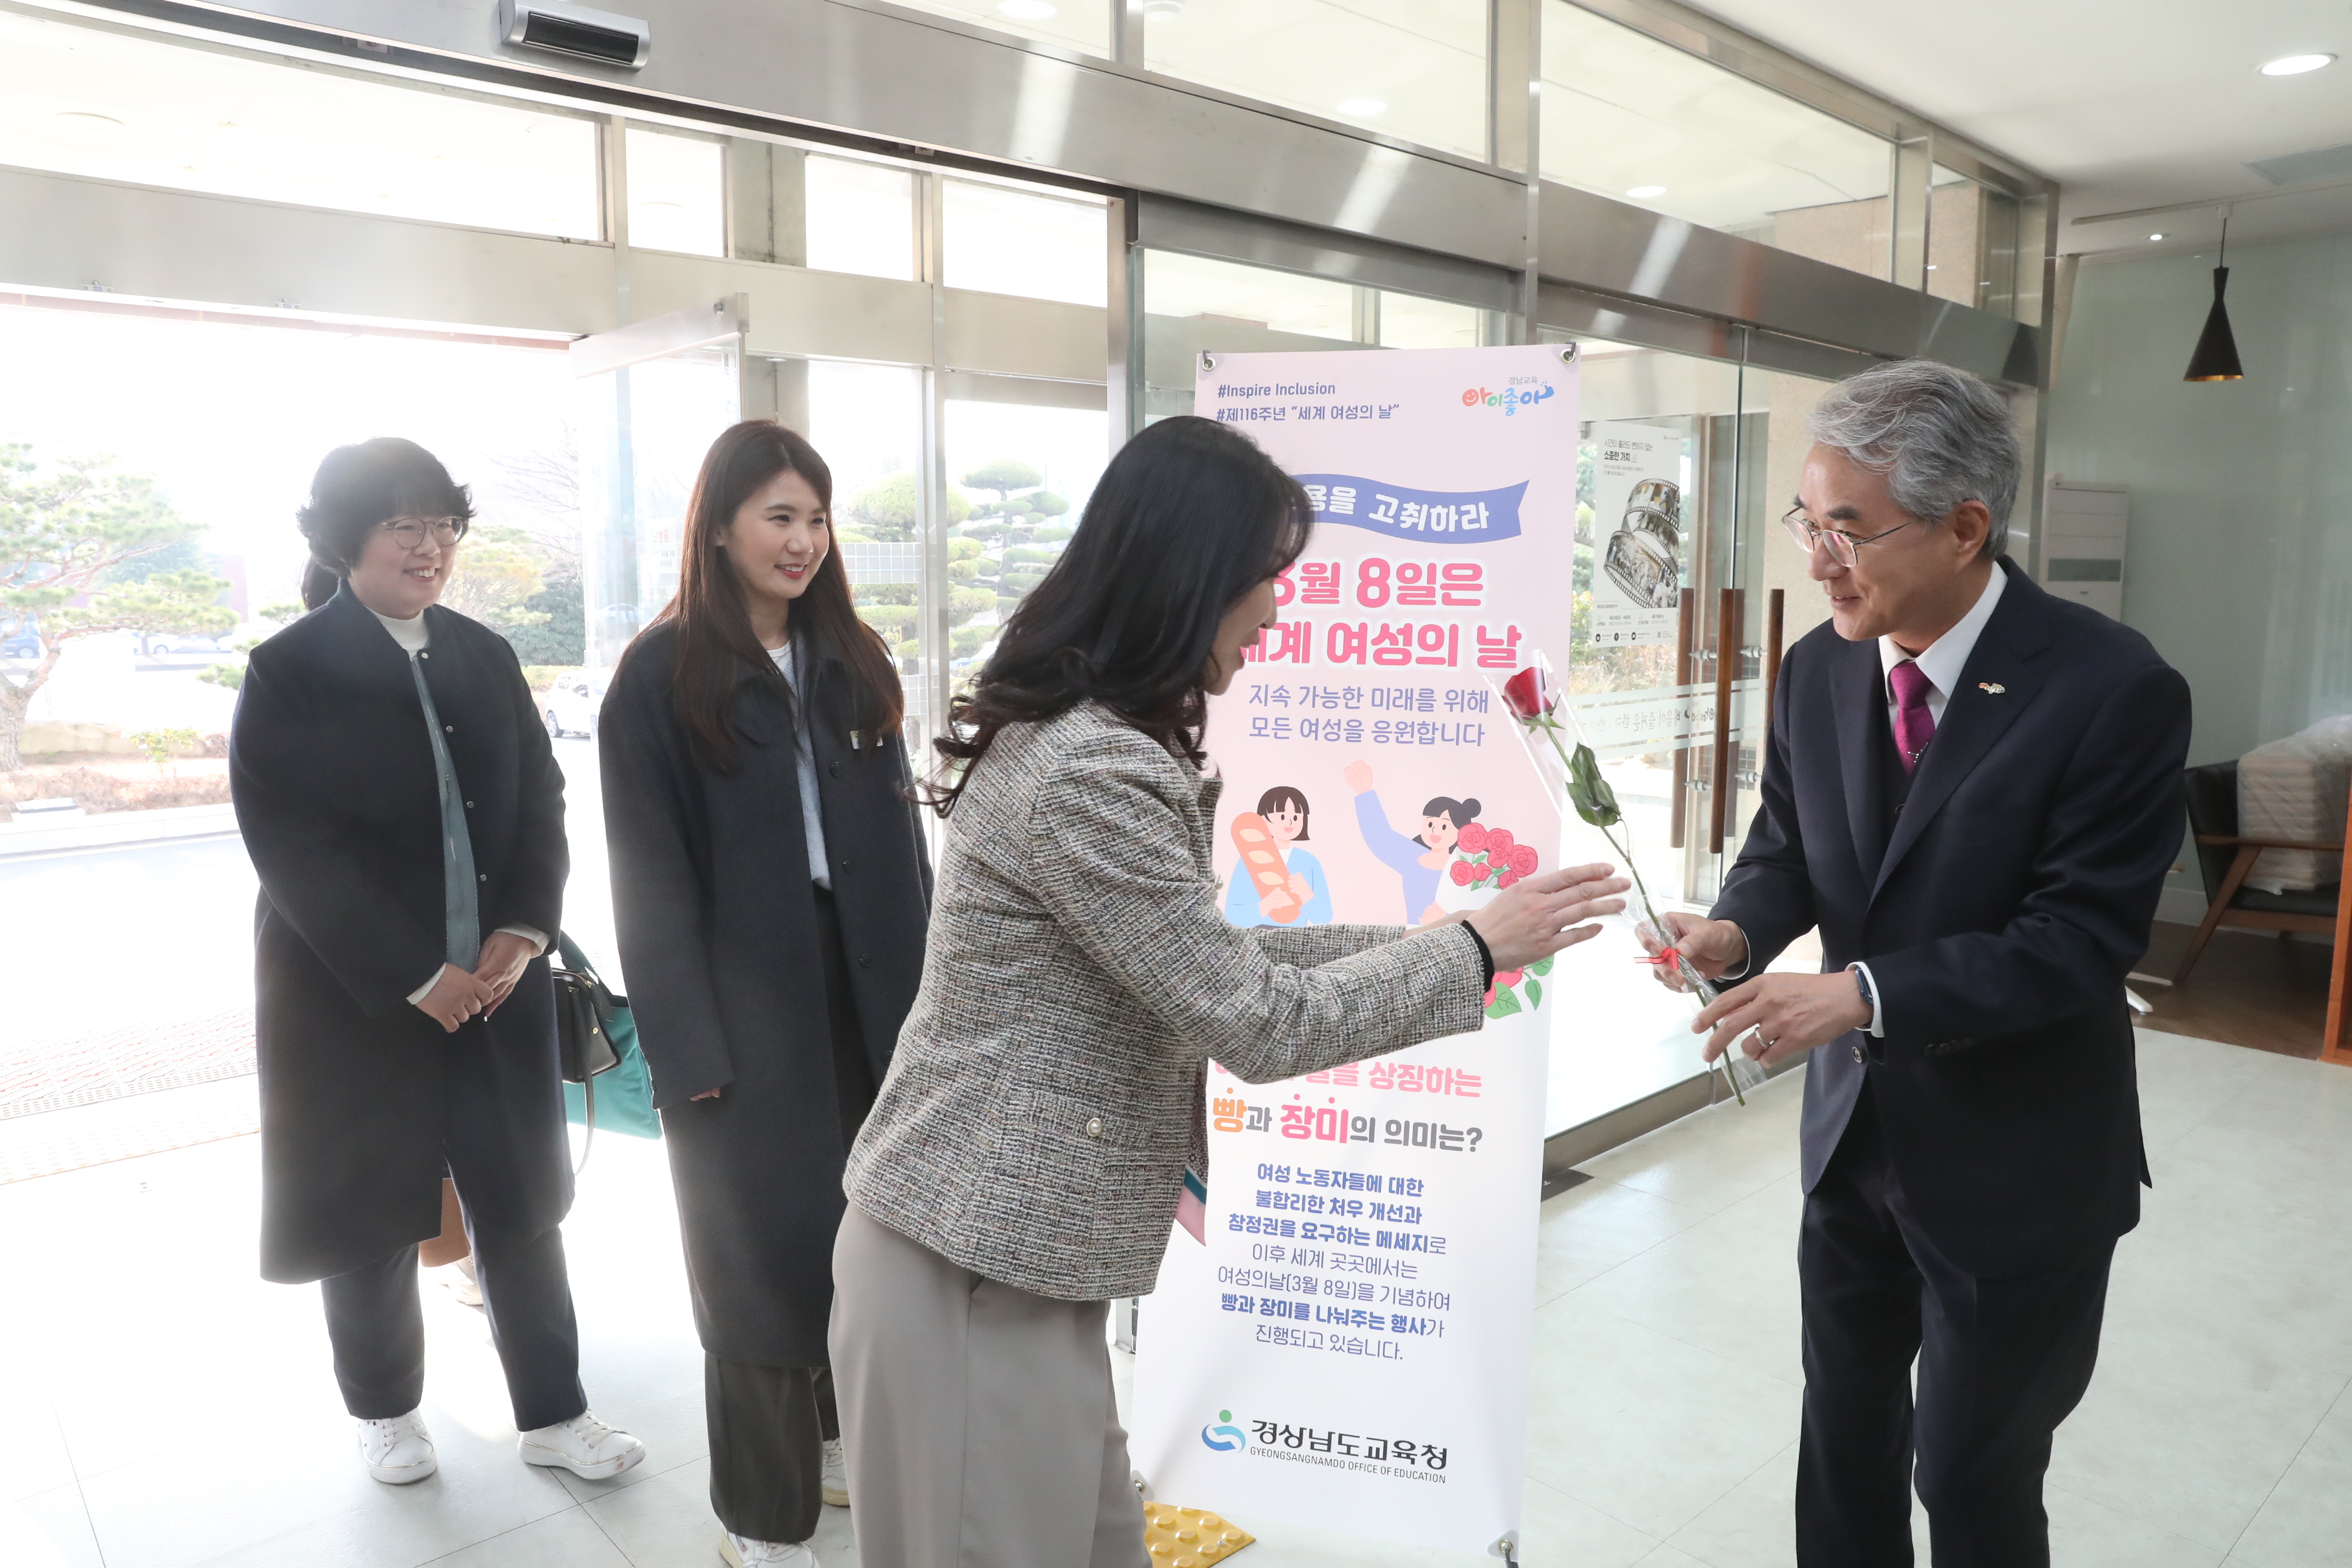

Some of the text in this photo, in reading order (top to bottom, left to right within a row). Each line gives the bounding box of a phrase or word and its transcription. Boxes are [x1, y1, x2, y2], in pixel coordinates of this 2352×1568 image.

[1218, 382, 1336, 398] #Inspire Inclusion
[1508, 376, 1538, 386] 경남교육
[1216, 407, 1286, 422] #제116주년
[1330, 405, 1373, 420] 여성의
[1462, 387, 1554, 416] 아이좋아
[1604, 451, 1631, 462] 소중한 가치
[1303, 484, 1490, 533] 용을 고취하라
[1357, 557, 1484, 609] 8일은
[1326, 622, 1458, 667] 여성의
[1476, 625, 1522, 669] 날
[1248, 684, 1489, 714] 지속 가능한 미래를 위해
[1248, 716, 1485, 747] 모든 여성을 응원합니다
[1367, 1061, 1482, 1098] 상징하는
[1212, 1087, 1483, 1153] 빵과 장미의 의미는?
[1257, 1162, 1424, 1198] 여성 노동자들에 대한
[1255, 1190, 1422, 1225] 불합리한 처우 개선과
[1228, 1213, 1447, 1255] 참정권을 요구하는 메세지로
[1251, 1242, 1418, 1280] 이후 세계 곳곳에서는
[1323, 1280, 1375, 1302] 8일)을
[1379, 1286, 1451, 1311] 기념하여
[1221, 1293, 1445, 1338] 빵과 장미를 나눠주는 행사가
[1255, 1323, 1404, 1361] 진행되고 있습니다.
[1251, 1420, 1448, 1469] 경상남도교육청
[1250, 1447, 1446, 1484] GYEONGSANGNAMDO OFFICE OF EDUCATION
